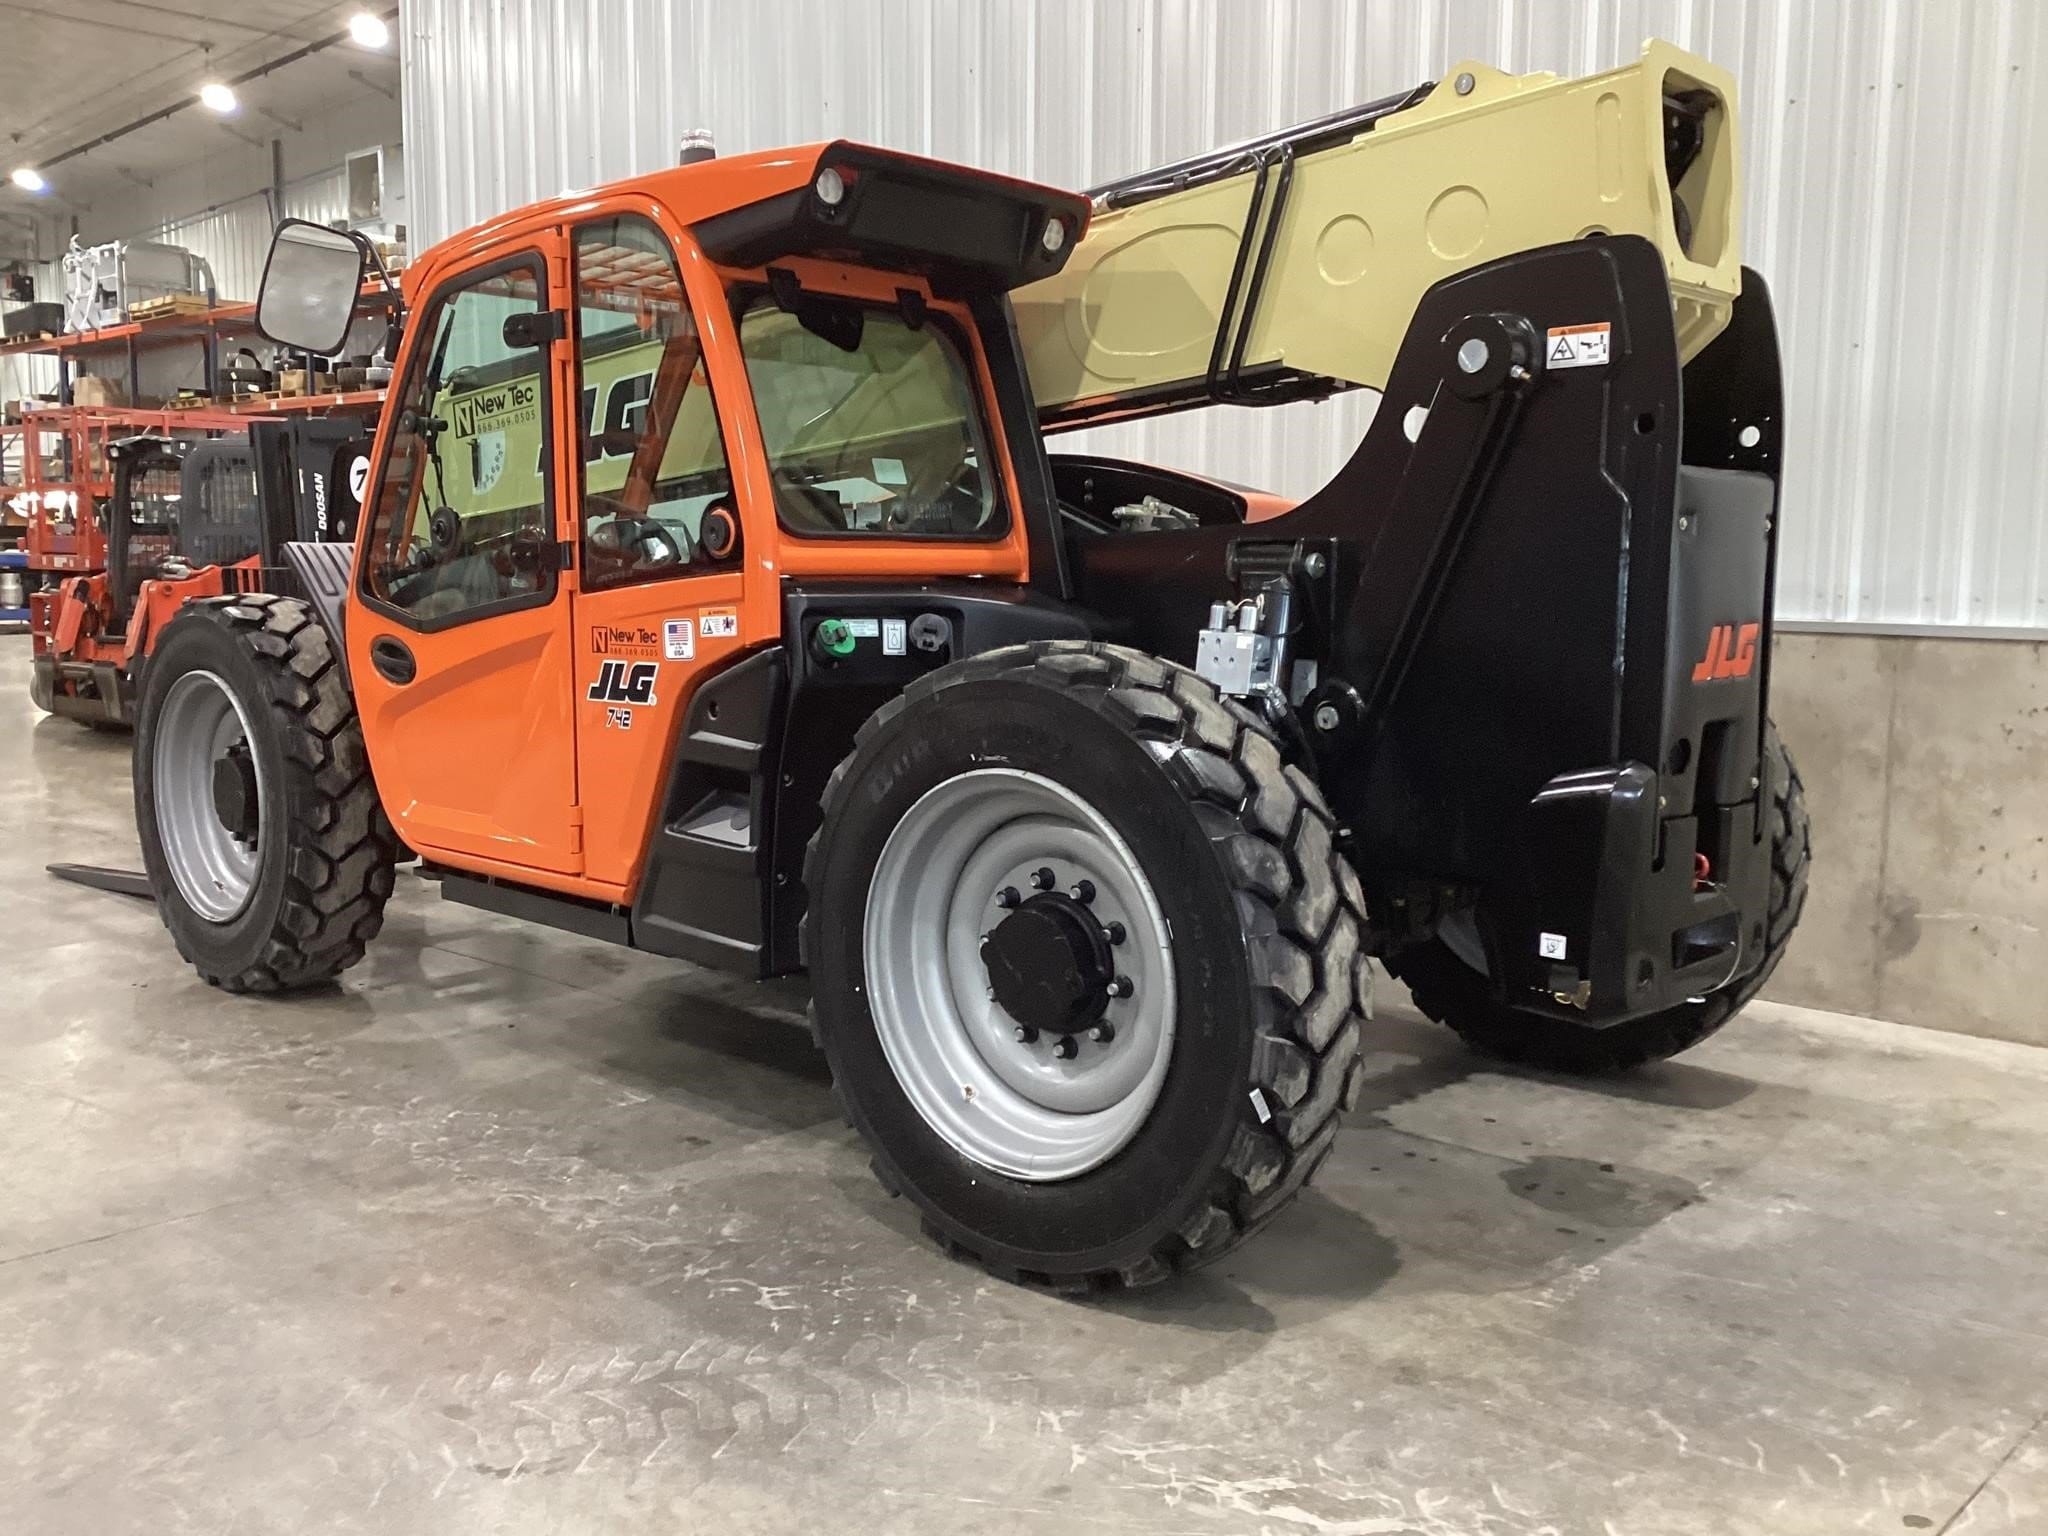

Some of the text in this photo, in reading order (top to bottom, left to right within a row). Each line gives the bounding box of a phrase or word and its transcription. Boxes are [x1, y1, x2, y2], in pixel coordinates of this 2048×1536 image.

[474, 384, 534, 416] New Tec
[356, 467, 368, 491] 7
[313, 472, 328, 531] DOOSAN
[609, 628, 658, 643] New Tec
[1692, 623, 1760, 682] JLG
[588, 661, 657, 704] JLG
[607, 708, 632, 728] 742
